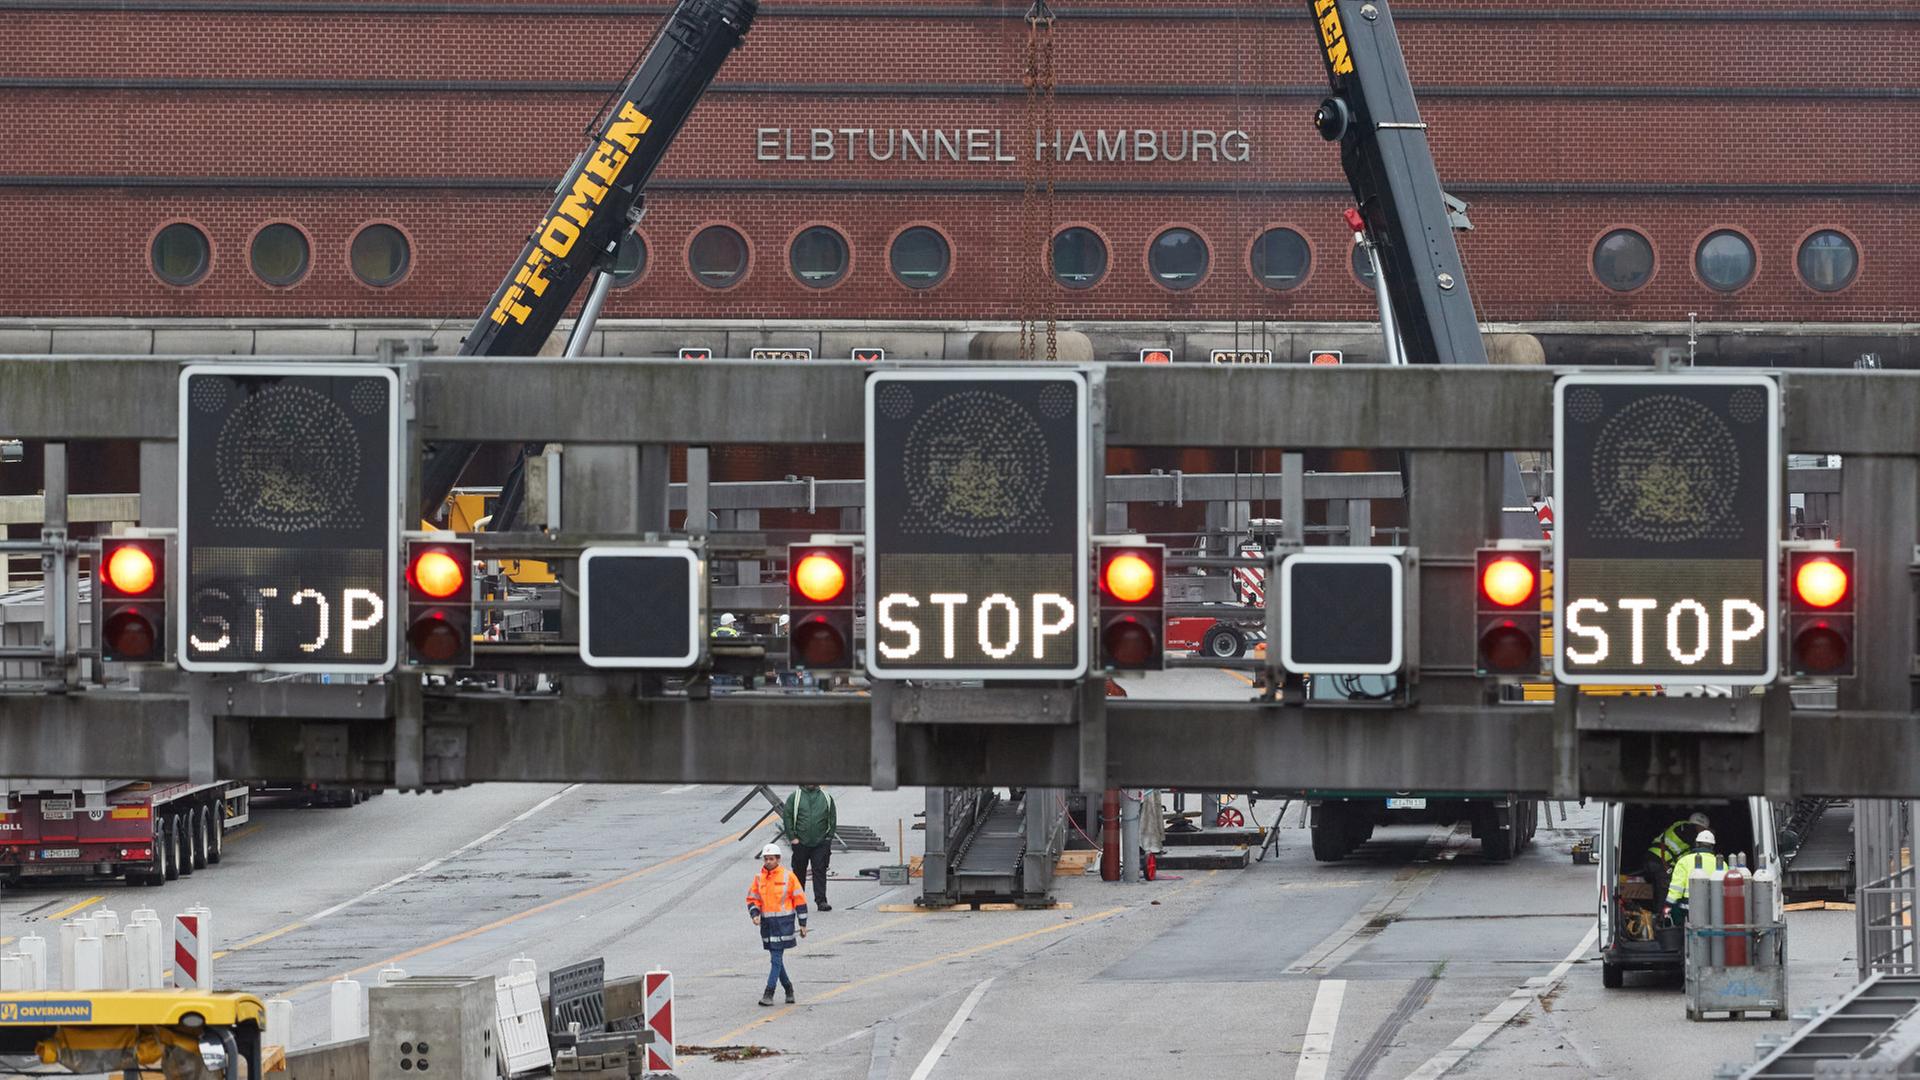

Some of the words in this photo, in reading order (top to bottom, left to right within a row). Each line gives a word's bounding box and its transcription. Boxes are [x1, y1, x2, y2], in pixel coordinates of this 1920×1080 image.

[758, 127, 1017, 162] ELBTUNNEL
[1036, 128, 1253, 162] HAMBURG
[192, 586, 383, 654] STOP
[878, 593, 1074, 659] STOP
[1566, 598, 1765, 665] STOP
[0, 823, 23, 831] OLL
[20, 1006, 89, 1016] OEVERMANN
